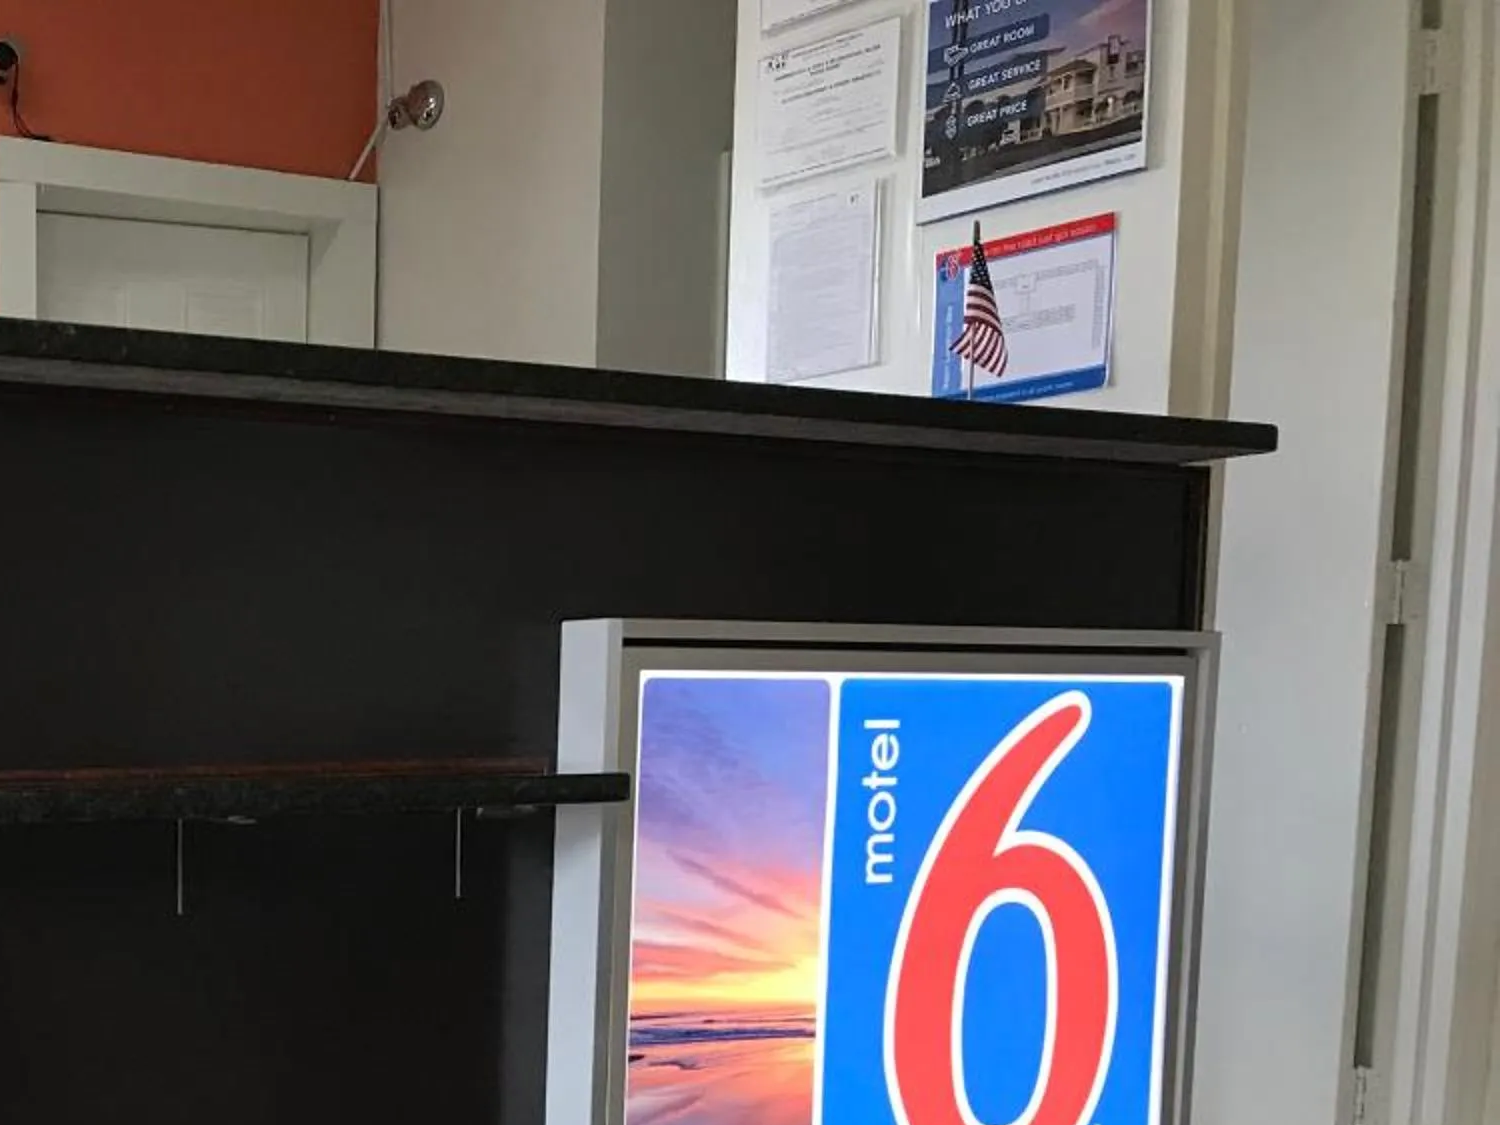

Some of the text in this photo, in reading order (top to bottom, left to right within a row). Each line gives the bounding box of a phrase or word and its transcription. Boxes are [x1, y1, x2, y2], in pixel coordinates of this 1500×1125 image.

[945, 5, 980, 28] WHAT
[969, 23, 1035, 53] GREAT ROOM
[968, 59, 1041, 90] GREAT SERVICE
[966, 99, 1027, 127] GREAT PRICE
[862, 719, 900, 884] motel
